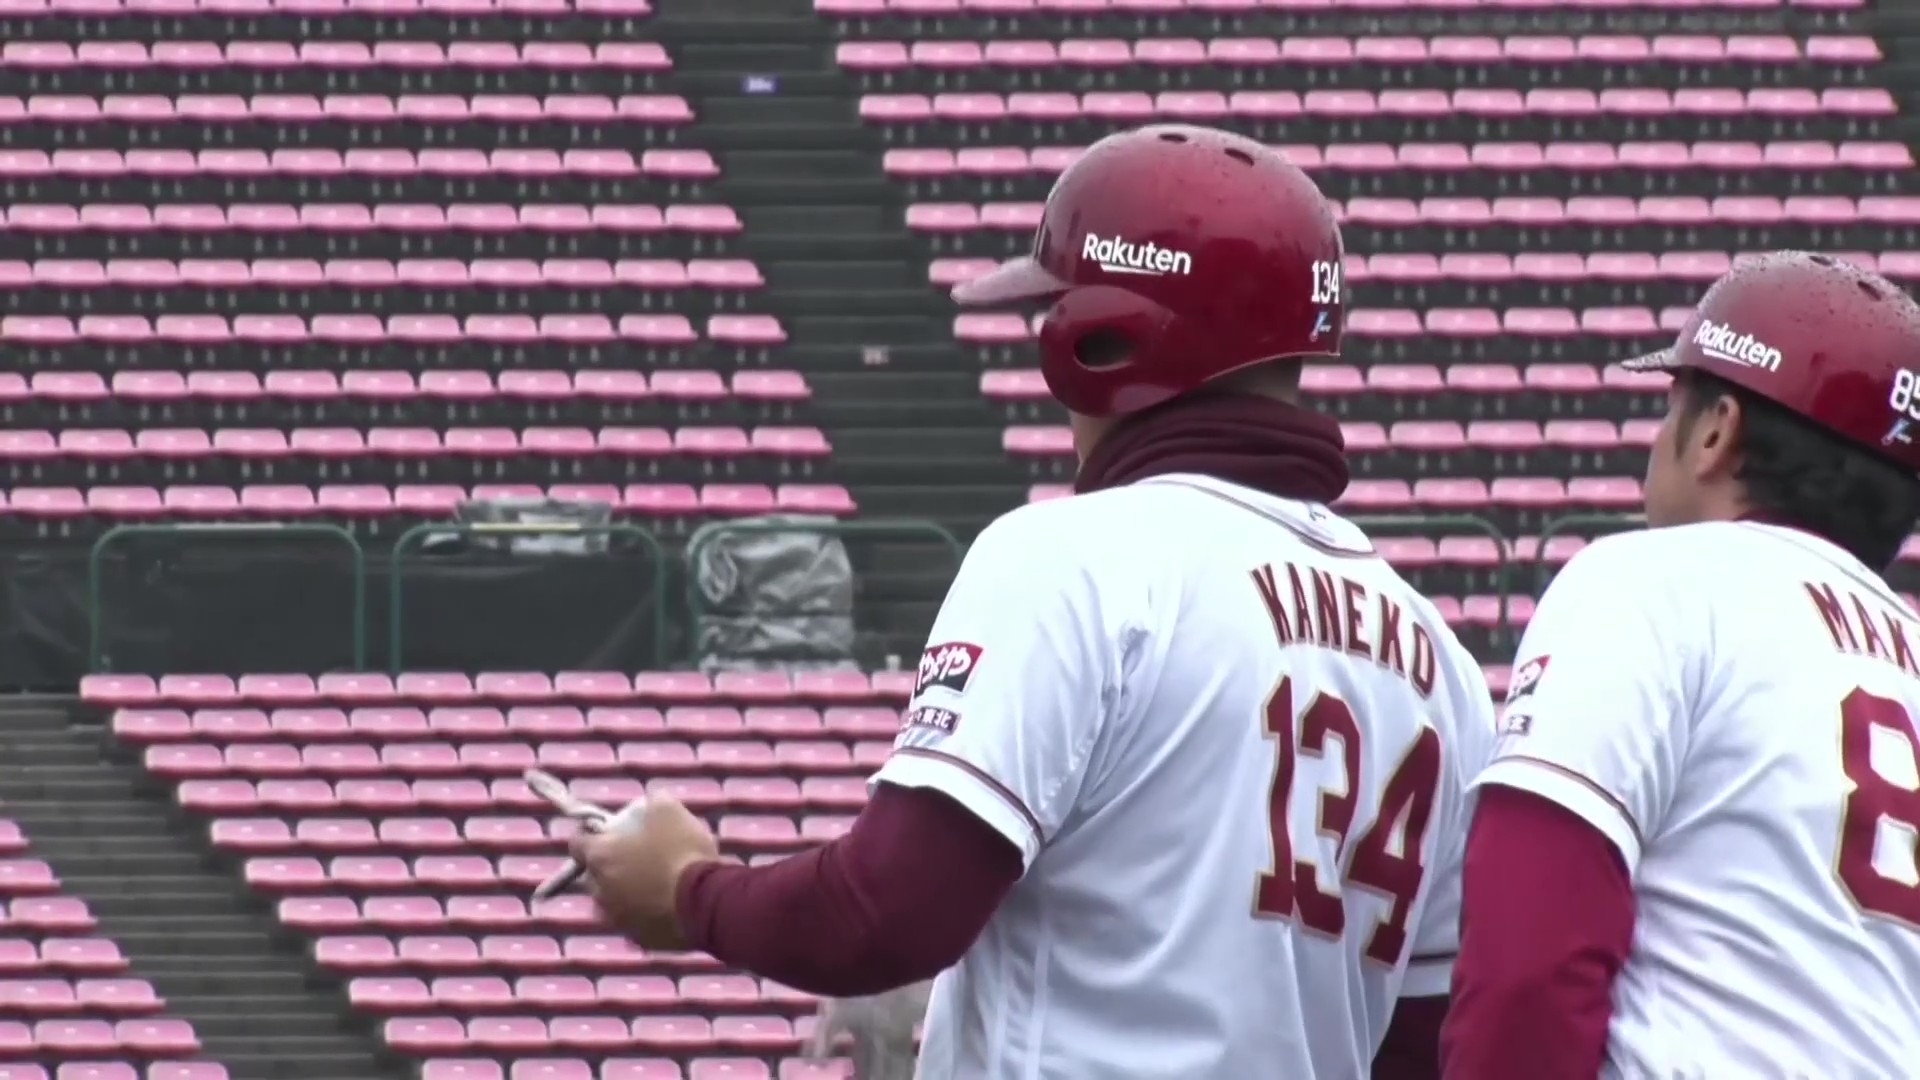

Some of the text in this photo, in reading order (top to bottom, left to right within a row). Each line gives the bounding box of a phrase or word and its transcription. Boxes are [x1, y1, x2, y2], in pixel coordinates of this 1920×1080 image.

[1082, 232, 1192, 275] Rakuten
[1311, 260, 1340, 305] 134
[1693, 319, 1782, 373] Rakuten
[1249, 561, 1437, 700] KANEKO
[1251, 670, 1442, 972] 134
